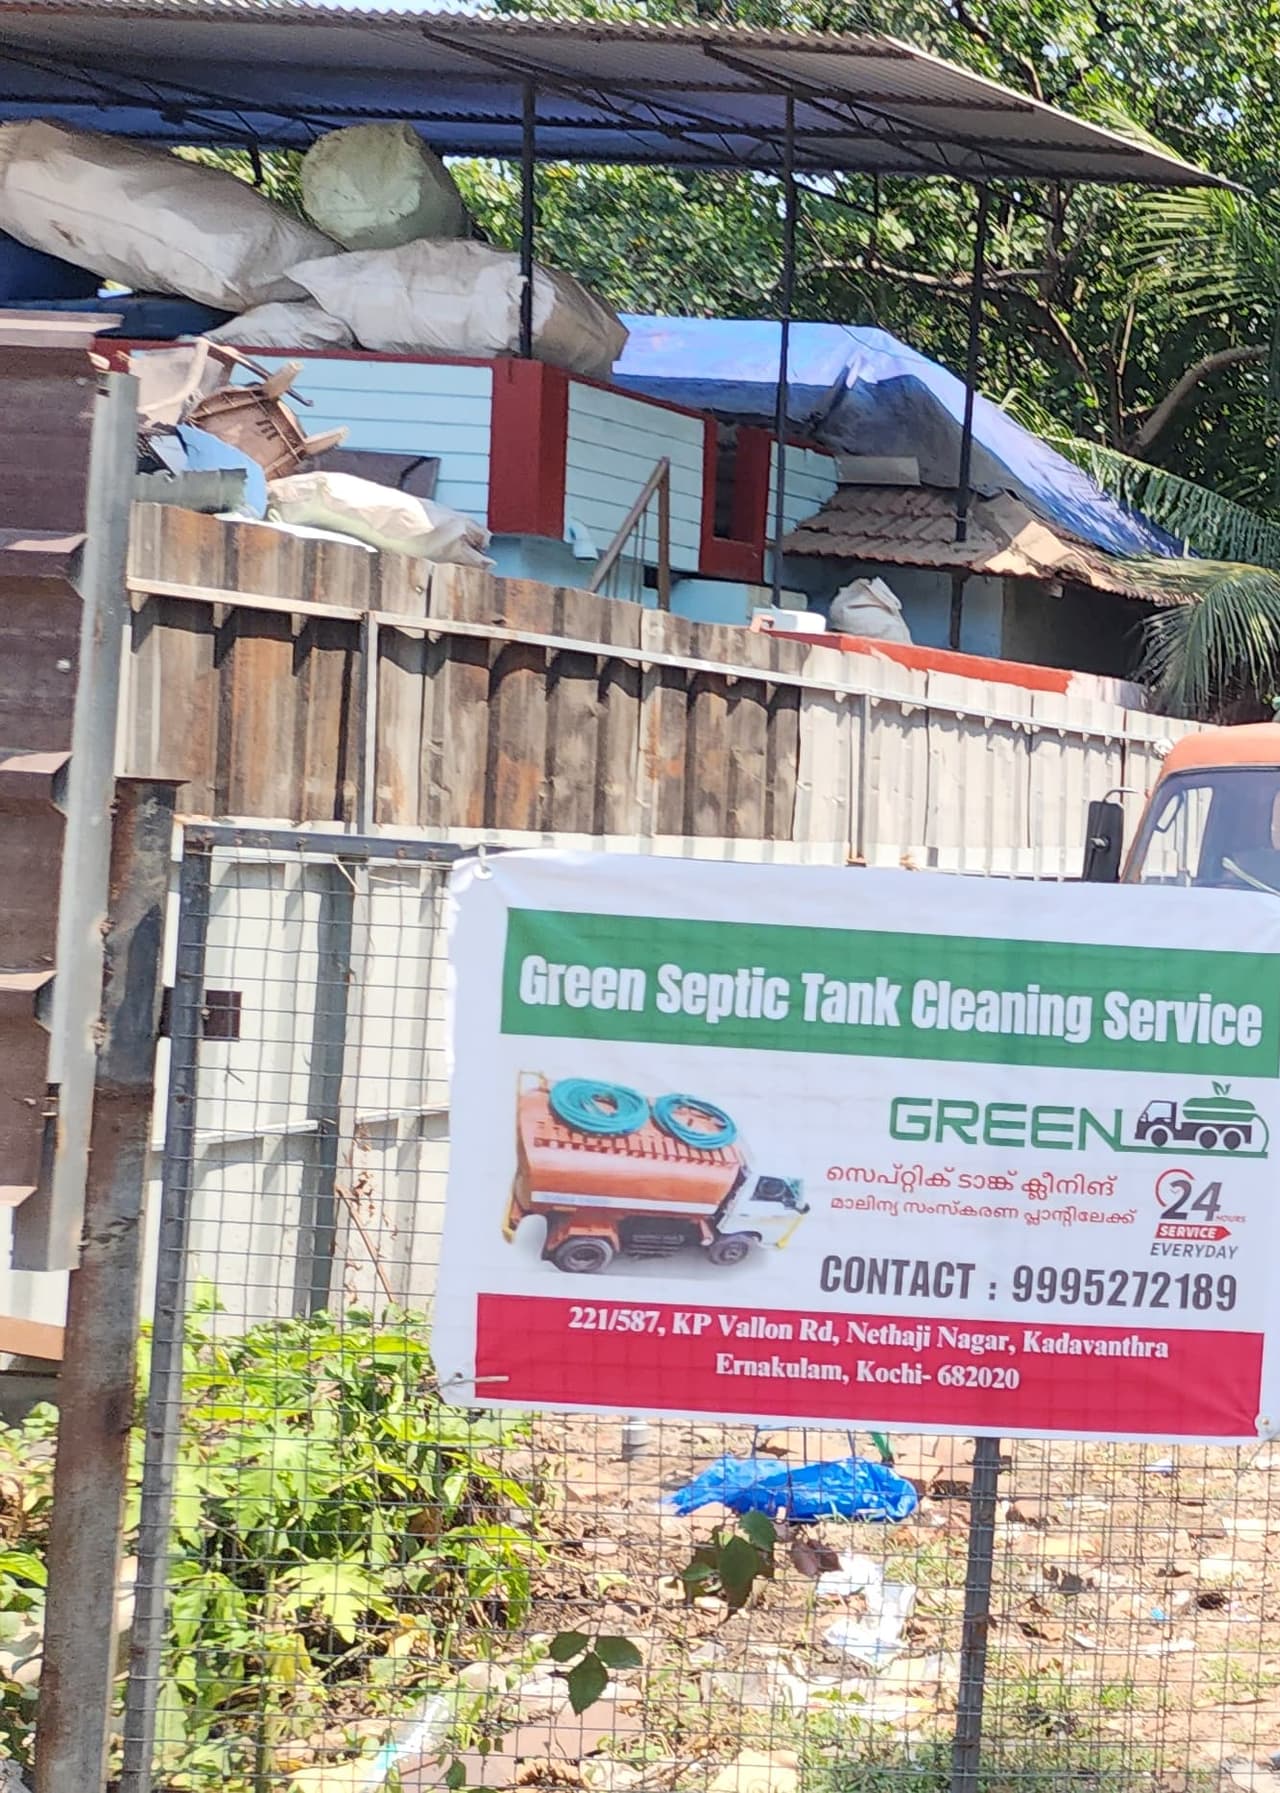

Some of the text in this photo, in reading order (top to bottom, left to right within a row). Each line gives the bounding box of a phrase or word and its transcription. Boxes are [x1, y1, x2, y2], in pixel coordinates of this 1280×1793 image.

[519, 954, 1262, 1047] Green Septic Tank Cleaning Service
[889, 1096, 1123, 1153] GREEN
[957, 1169, 1018, 1192] ടാങ്ക്
[1160, 1179, 1223, 1222] 24
[1150, 1242, 1239, 1260] EVERYDAY
[1159, 1224, 1218, 1240] SERVICE
[820, 1254, 976, 1300] CONTACT
[1011, 1265, 1238, 1312] 9995272189
[568, 1306, 1169, 1359] 221/587, KP Vallon Rd, Nethaji Nagar, Kadavanthra
[715, 1352, 1020, 1391] Ernakulam, Kochi- 682020
